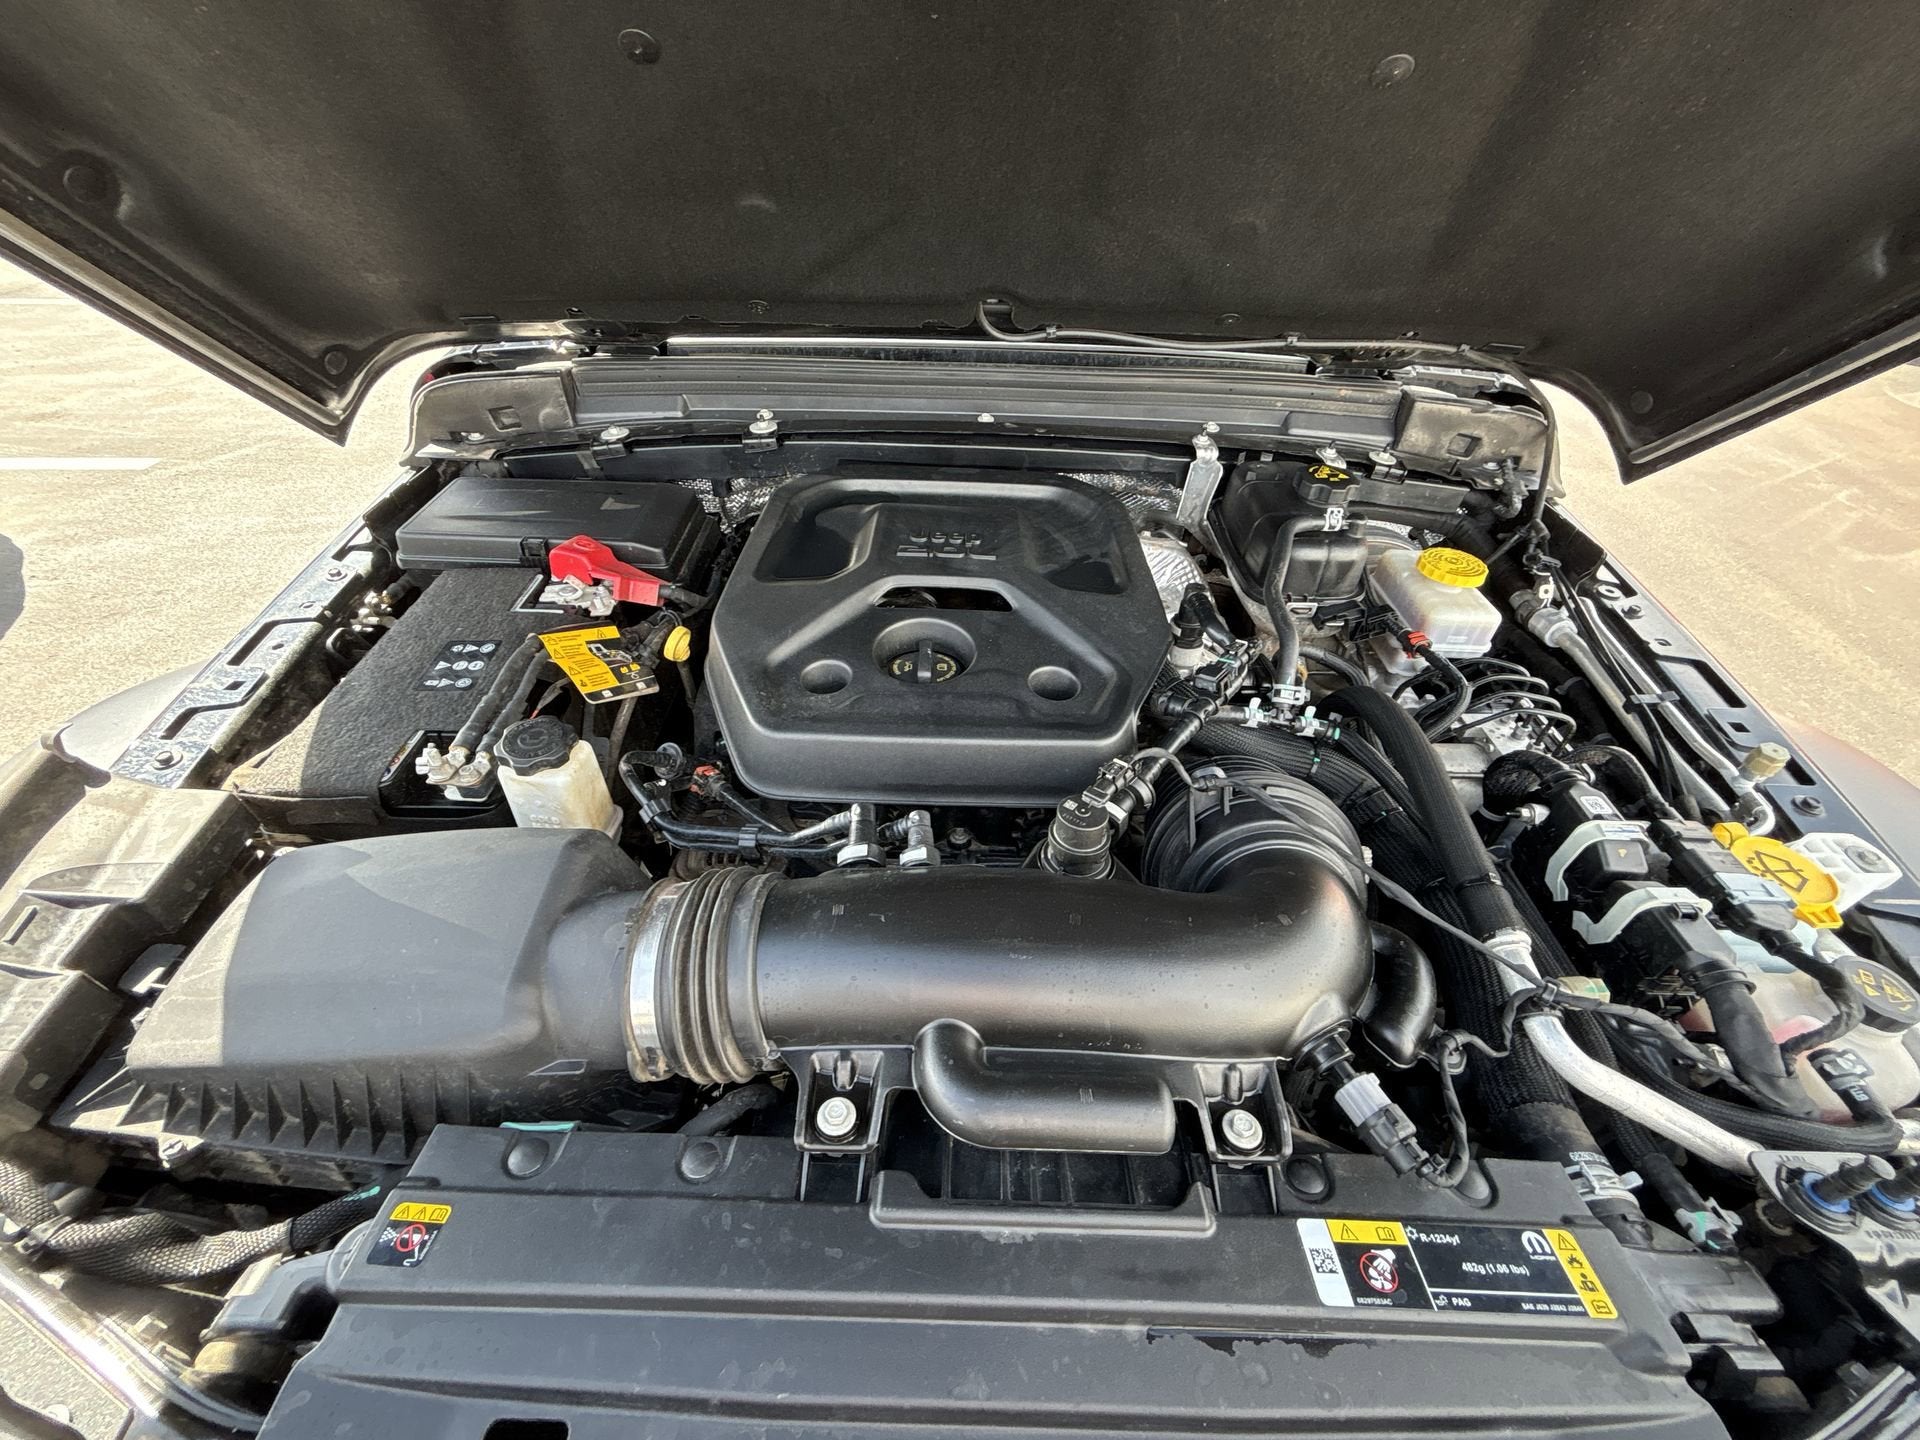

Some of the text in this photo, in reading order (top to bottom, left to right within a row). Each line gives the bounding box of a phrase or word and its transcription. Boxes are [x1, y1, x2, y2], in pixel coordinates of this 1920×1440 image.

[1419, 1233, 1461, 1246] R-1234yf
[1462, 1261, 1486, 1275] 482g
[1509, 1264, 1530, 1277] lbs)
[1451, 1296, 1472, 1307] PAG
